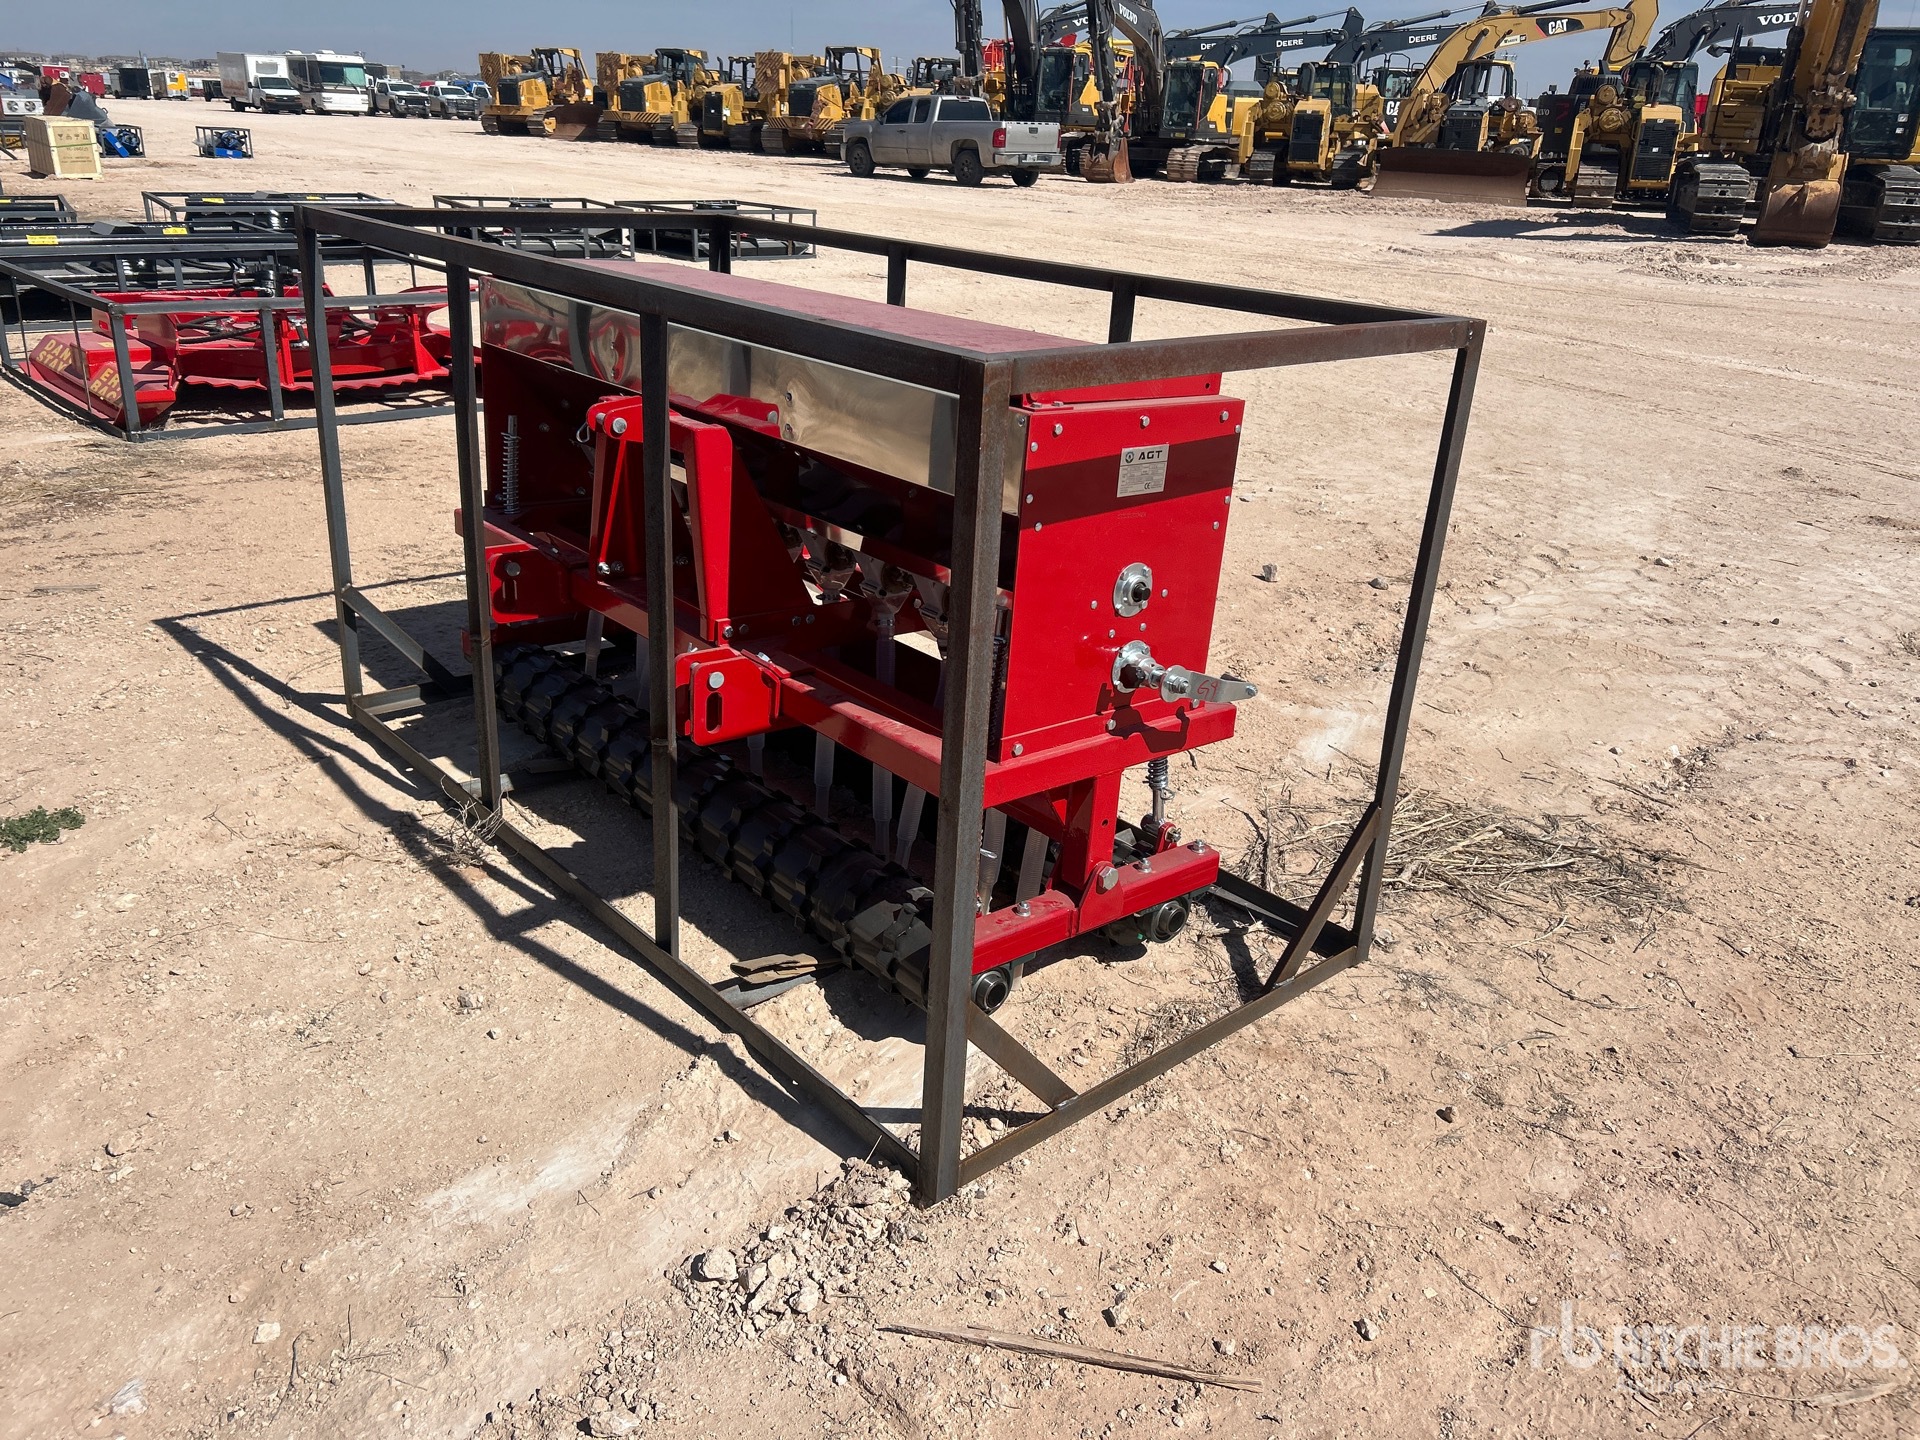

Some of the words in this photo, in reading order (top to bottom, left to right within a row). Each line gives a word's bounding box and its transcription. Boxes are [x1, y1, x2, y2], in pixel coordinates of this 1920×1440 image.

[1118, 3, 1138, 25] VOLVO
[1548, 19, 1568, 35] CAT
[1276, 39, 1304, 48] DEERE
[1408, 33, 1438, 44] DEERE
[1386, 101, 1400, 116] CA
[90, 378, 118, 399] BAC
[1138, 450, 1163, 461] AGT
